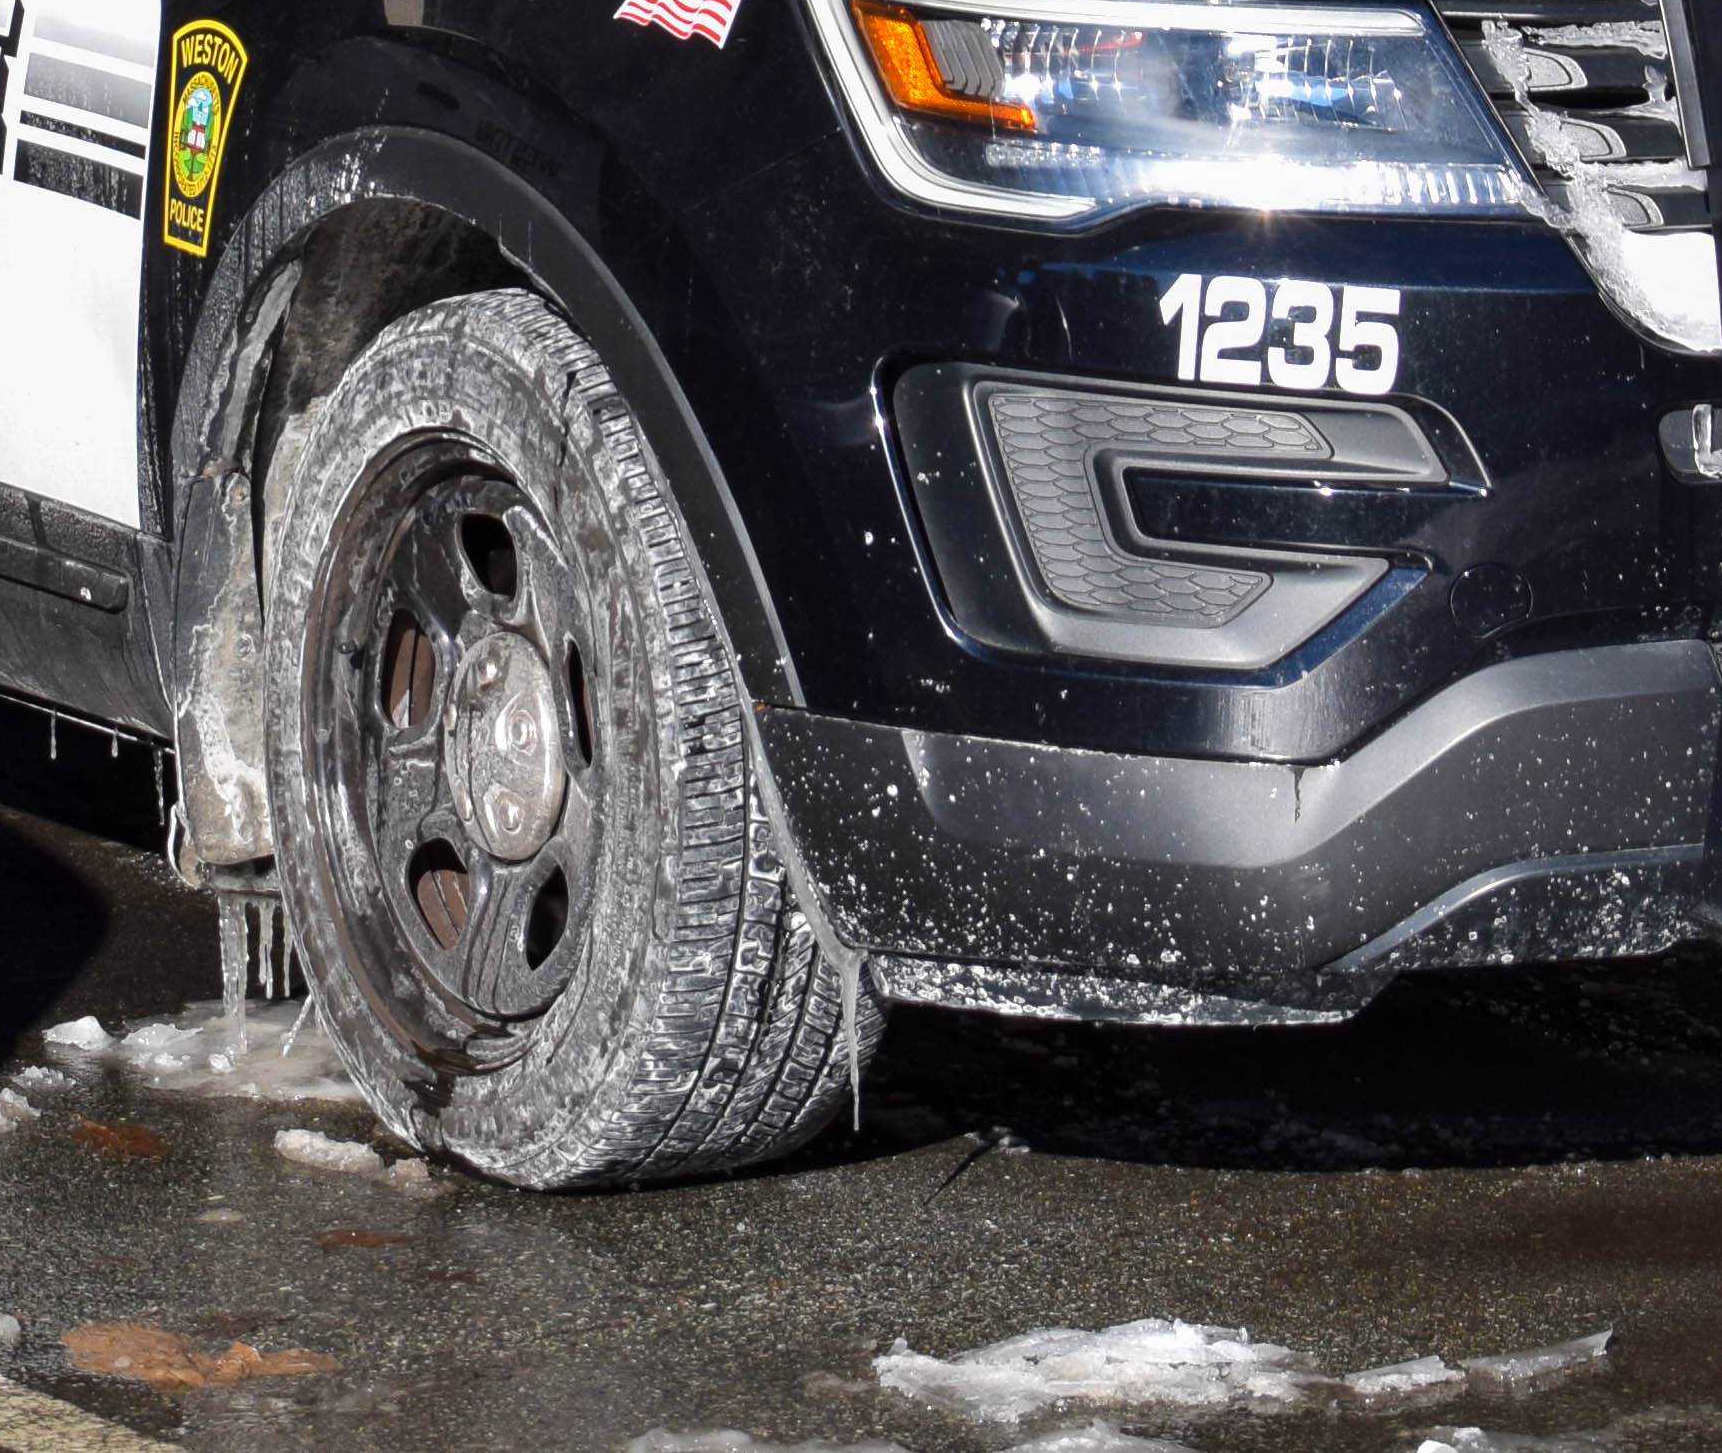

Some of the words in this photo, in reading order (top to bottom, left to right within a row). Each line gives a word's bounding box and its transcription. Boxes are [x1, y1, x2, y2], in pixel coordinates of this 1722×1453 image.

[180, 33, 240, 85] WESTON
[169, 198, 205, 233] POLICE
[1158, 273, 1402, 396] 1235
